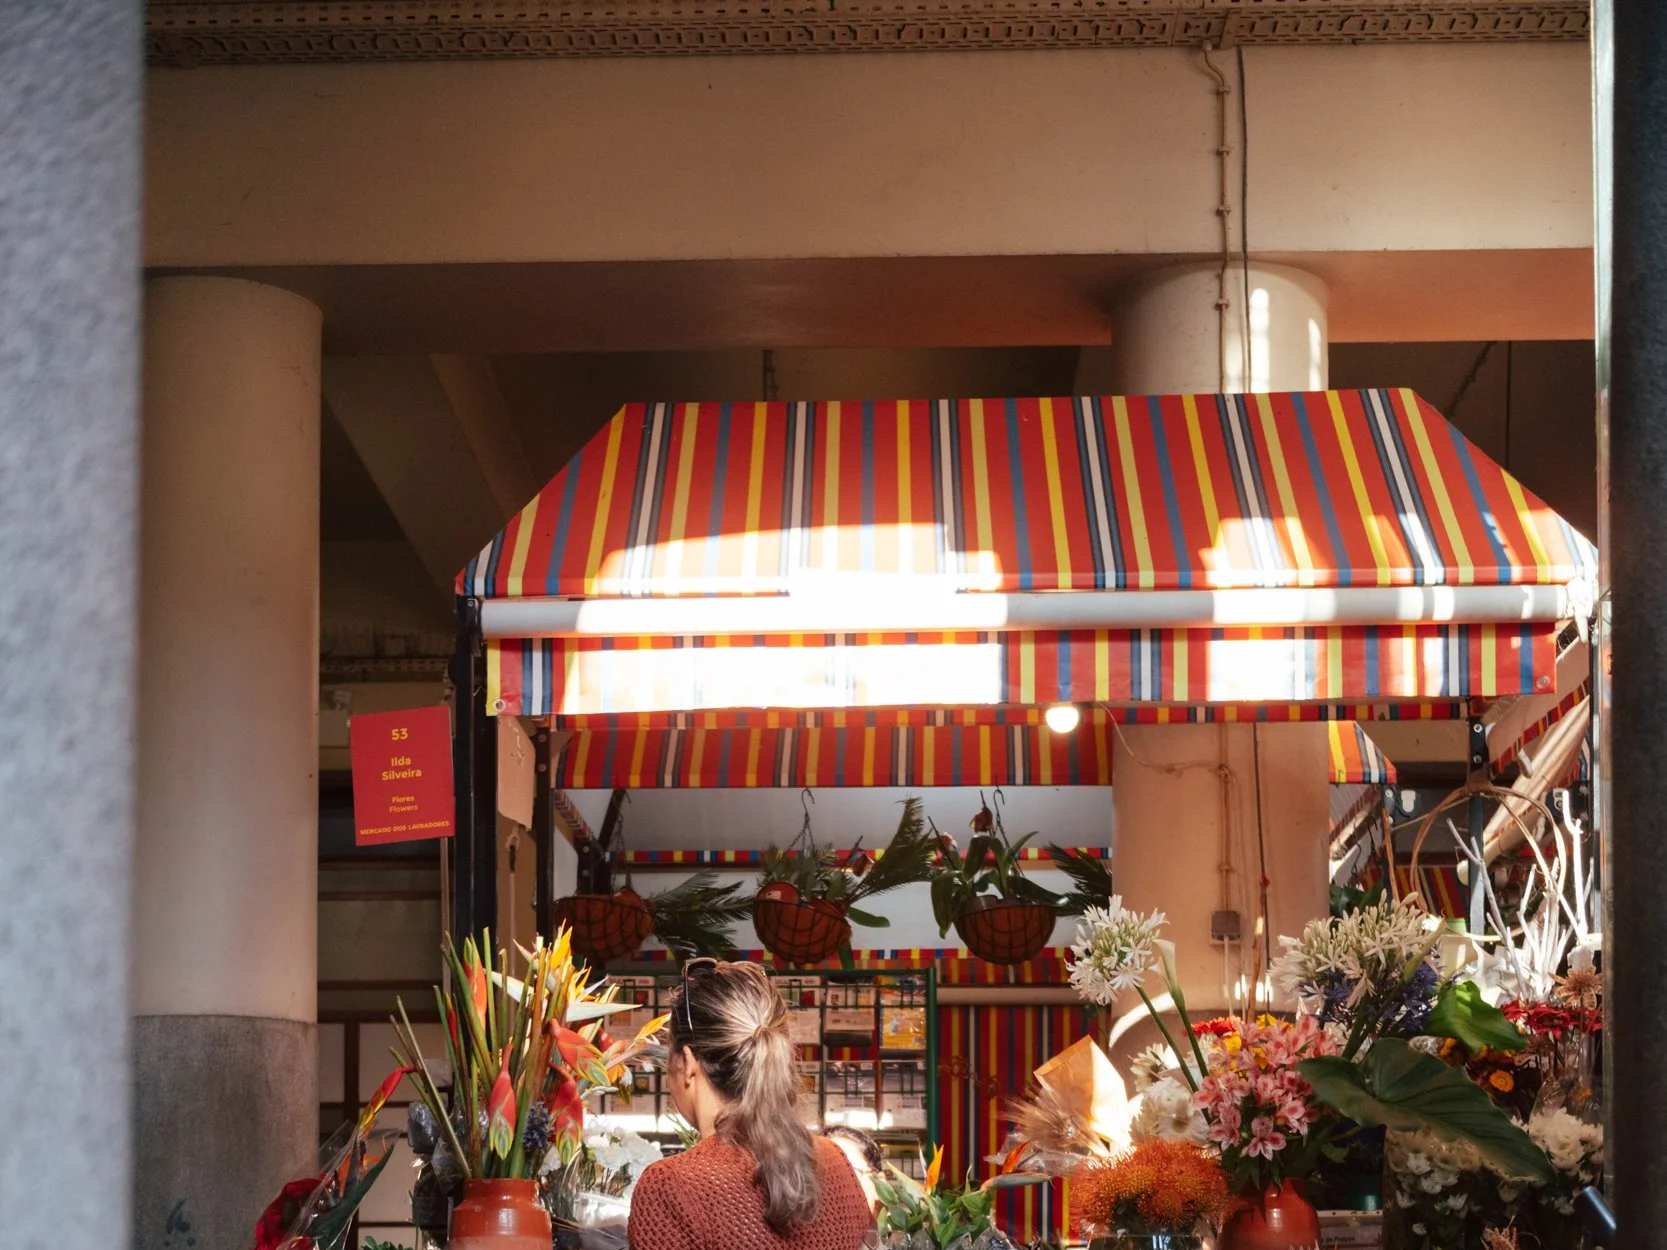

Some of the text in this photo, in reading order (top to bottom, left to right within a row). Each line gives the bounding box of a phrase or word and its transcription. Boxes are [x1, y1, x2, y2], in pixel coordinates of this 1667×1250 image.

[391, 728, 408, 740] 53
[391, 757, 411, 766] Ilda
[382, 769, 422, 780] Silveira
[389, 804, 418, 813] Flowers
[408, 821, 450, 831] LAVRADORES
